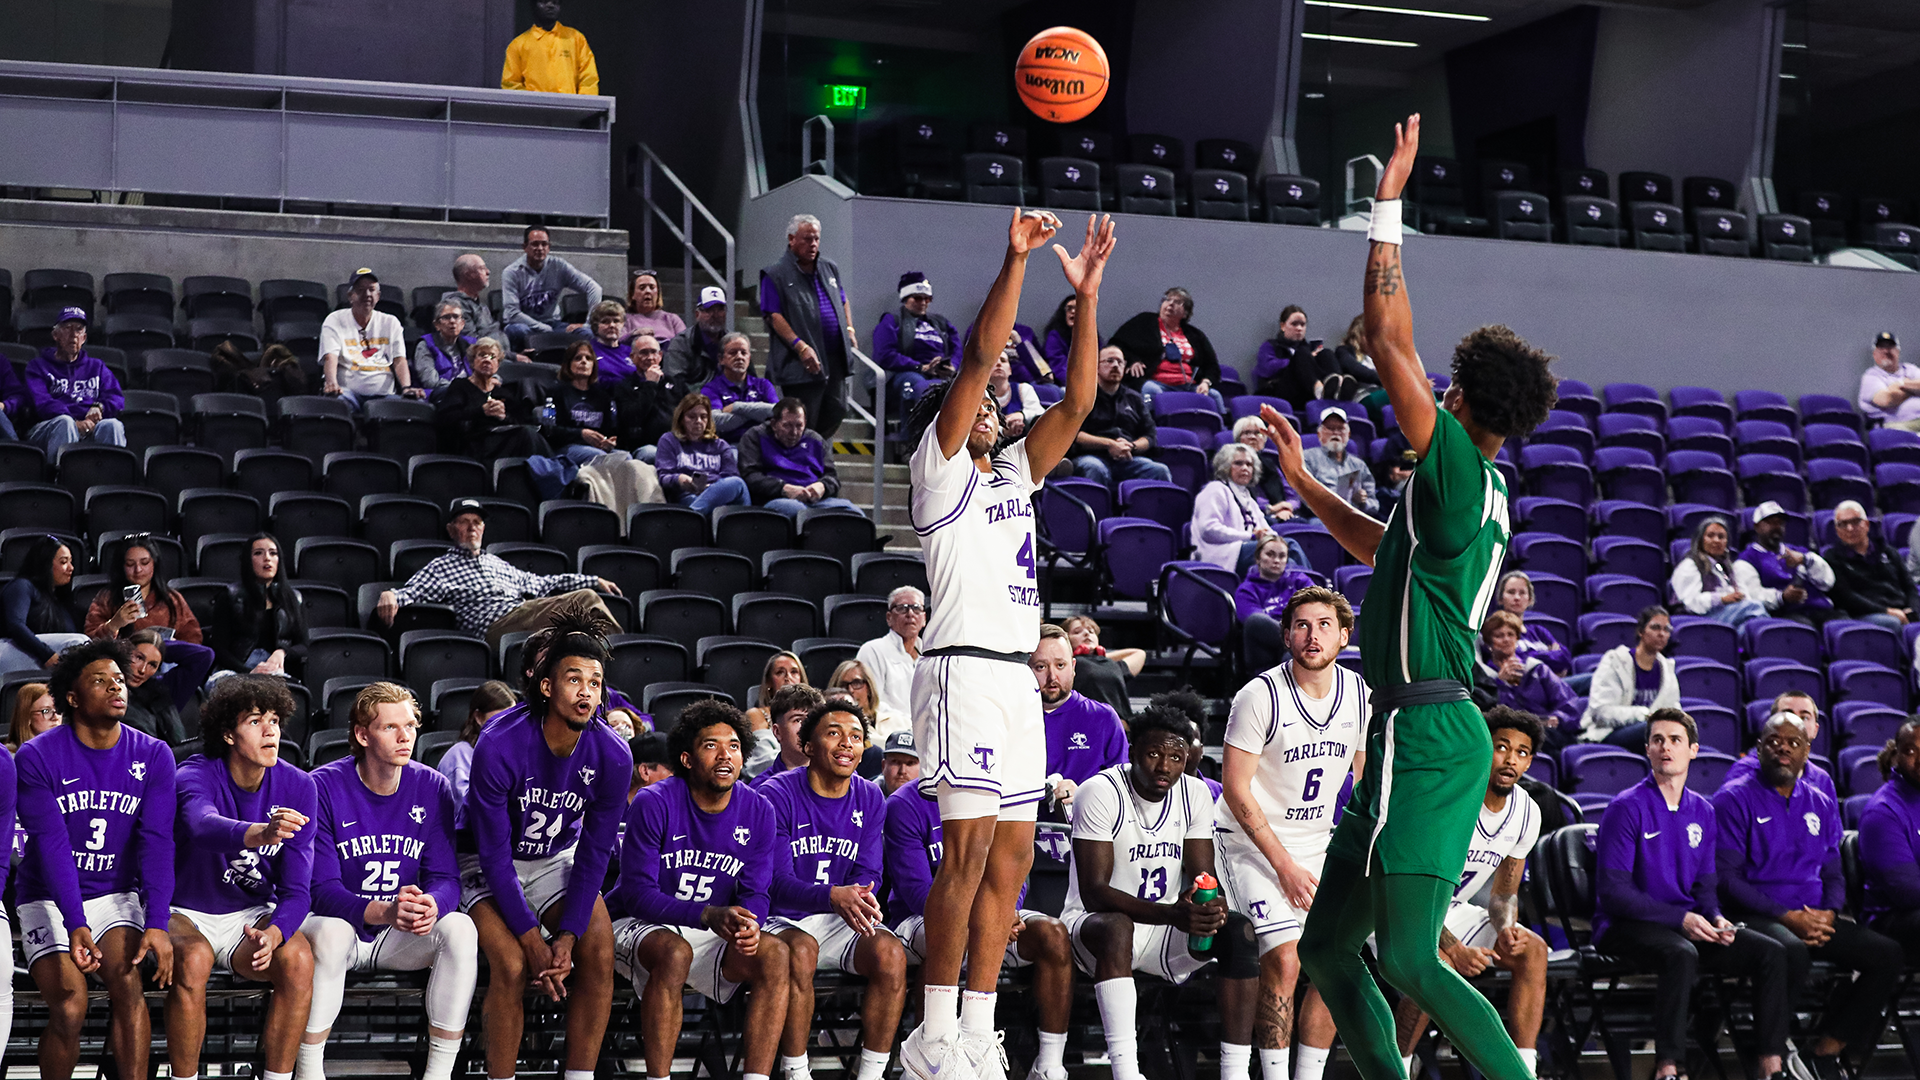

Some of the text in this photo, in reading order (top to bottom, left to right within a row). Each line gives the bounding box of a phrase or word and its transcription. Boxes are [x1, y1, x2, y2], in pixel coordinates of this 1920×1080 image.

[1035, 46, 1081, 65] NCAA
[1025, 74, 1085, 95] Wilson
[1016, 532, 1035, 579] 4
[1283, 741, 1348, 764] TARLETON
[1302, 768, 1324, 802] 6
[56, 790, 141, 815] TARLETON
[1285, 805, 1325, 820] STATE
[85, 818, 107, 850] 3
[336, 834, 425, 860] TARLETON
[516, 841, 552, 855] STA
[790, 835, 860, 861] TARLETON
[1129, 842, 1182, 862] TRLETON
[361, 861, 401, 892] 25
[661, 850, 745, 877] TARLETON
[814, 859, 832, 885] 5
[674, 872, 716, 902] 55
[1452, 870, 1478, 898] 7
